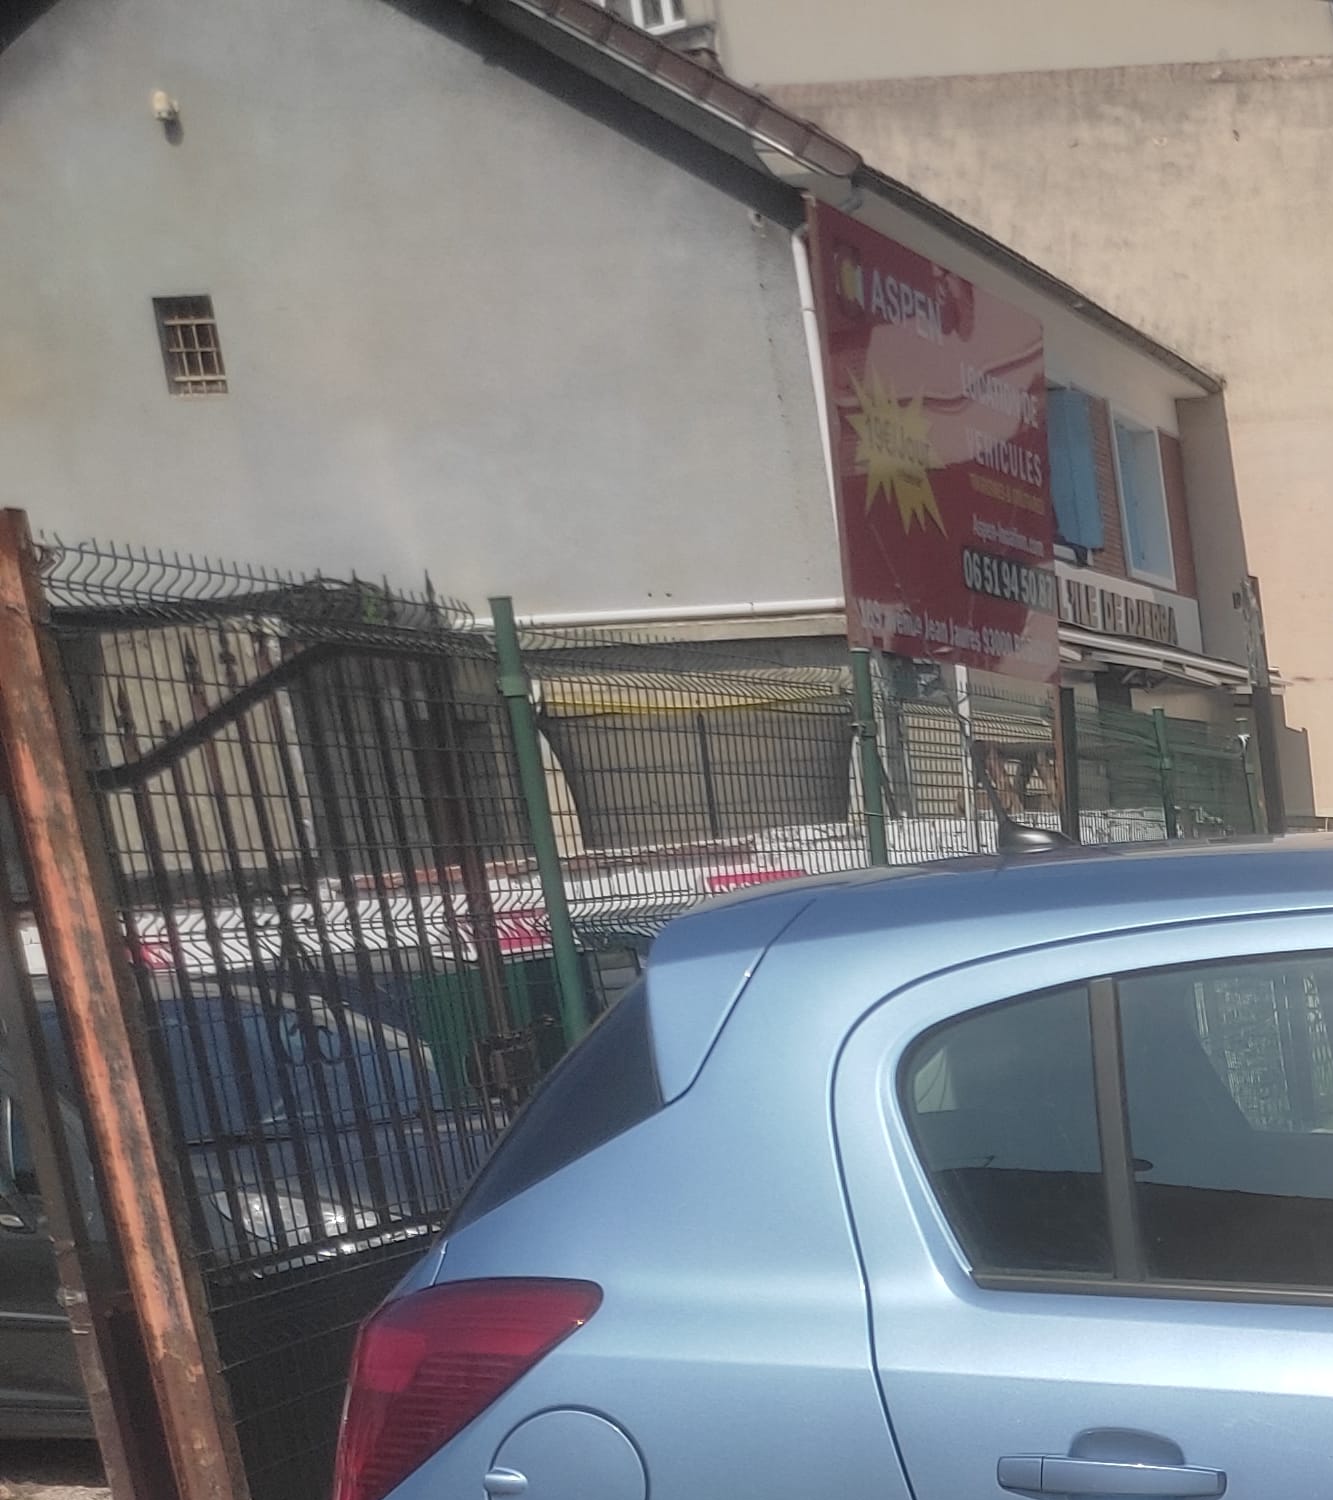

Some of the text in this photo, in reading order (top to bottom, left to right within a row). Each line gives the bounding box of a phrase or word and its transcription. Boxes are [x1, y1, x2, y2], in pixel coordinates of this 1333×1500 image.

[871, 269, 944, 346] ASPEN
[960, 361, 1022, 422] LOCATION
[963, 549, 982, 591] 06
[983, 556, 1001, 597] 51
[1002, 561, 1020, 602] 94
[1100, 589, 1124, 632] DE
[1125, 597, 1178, 646] DJERBA
